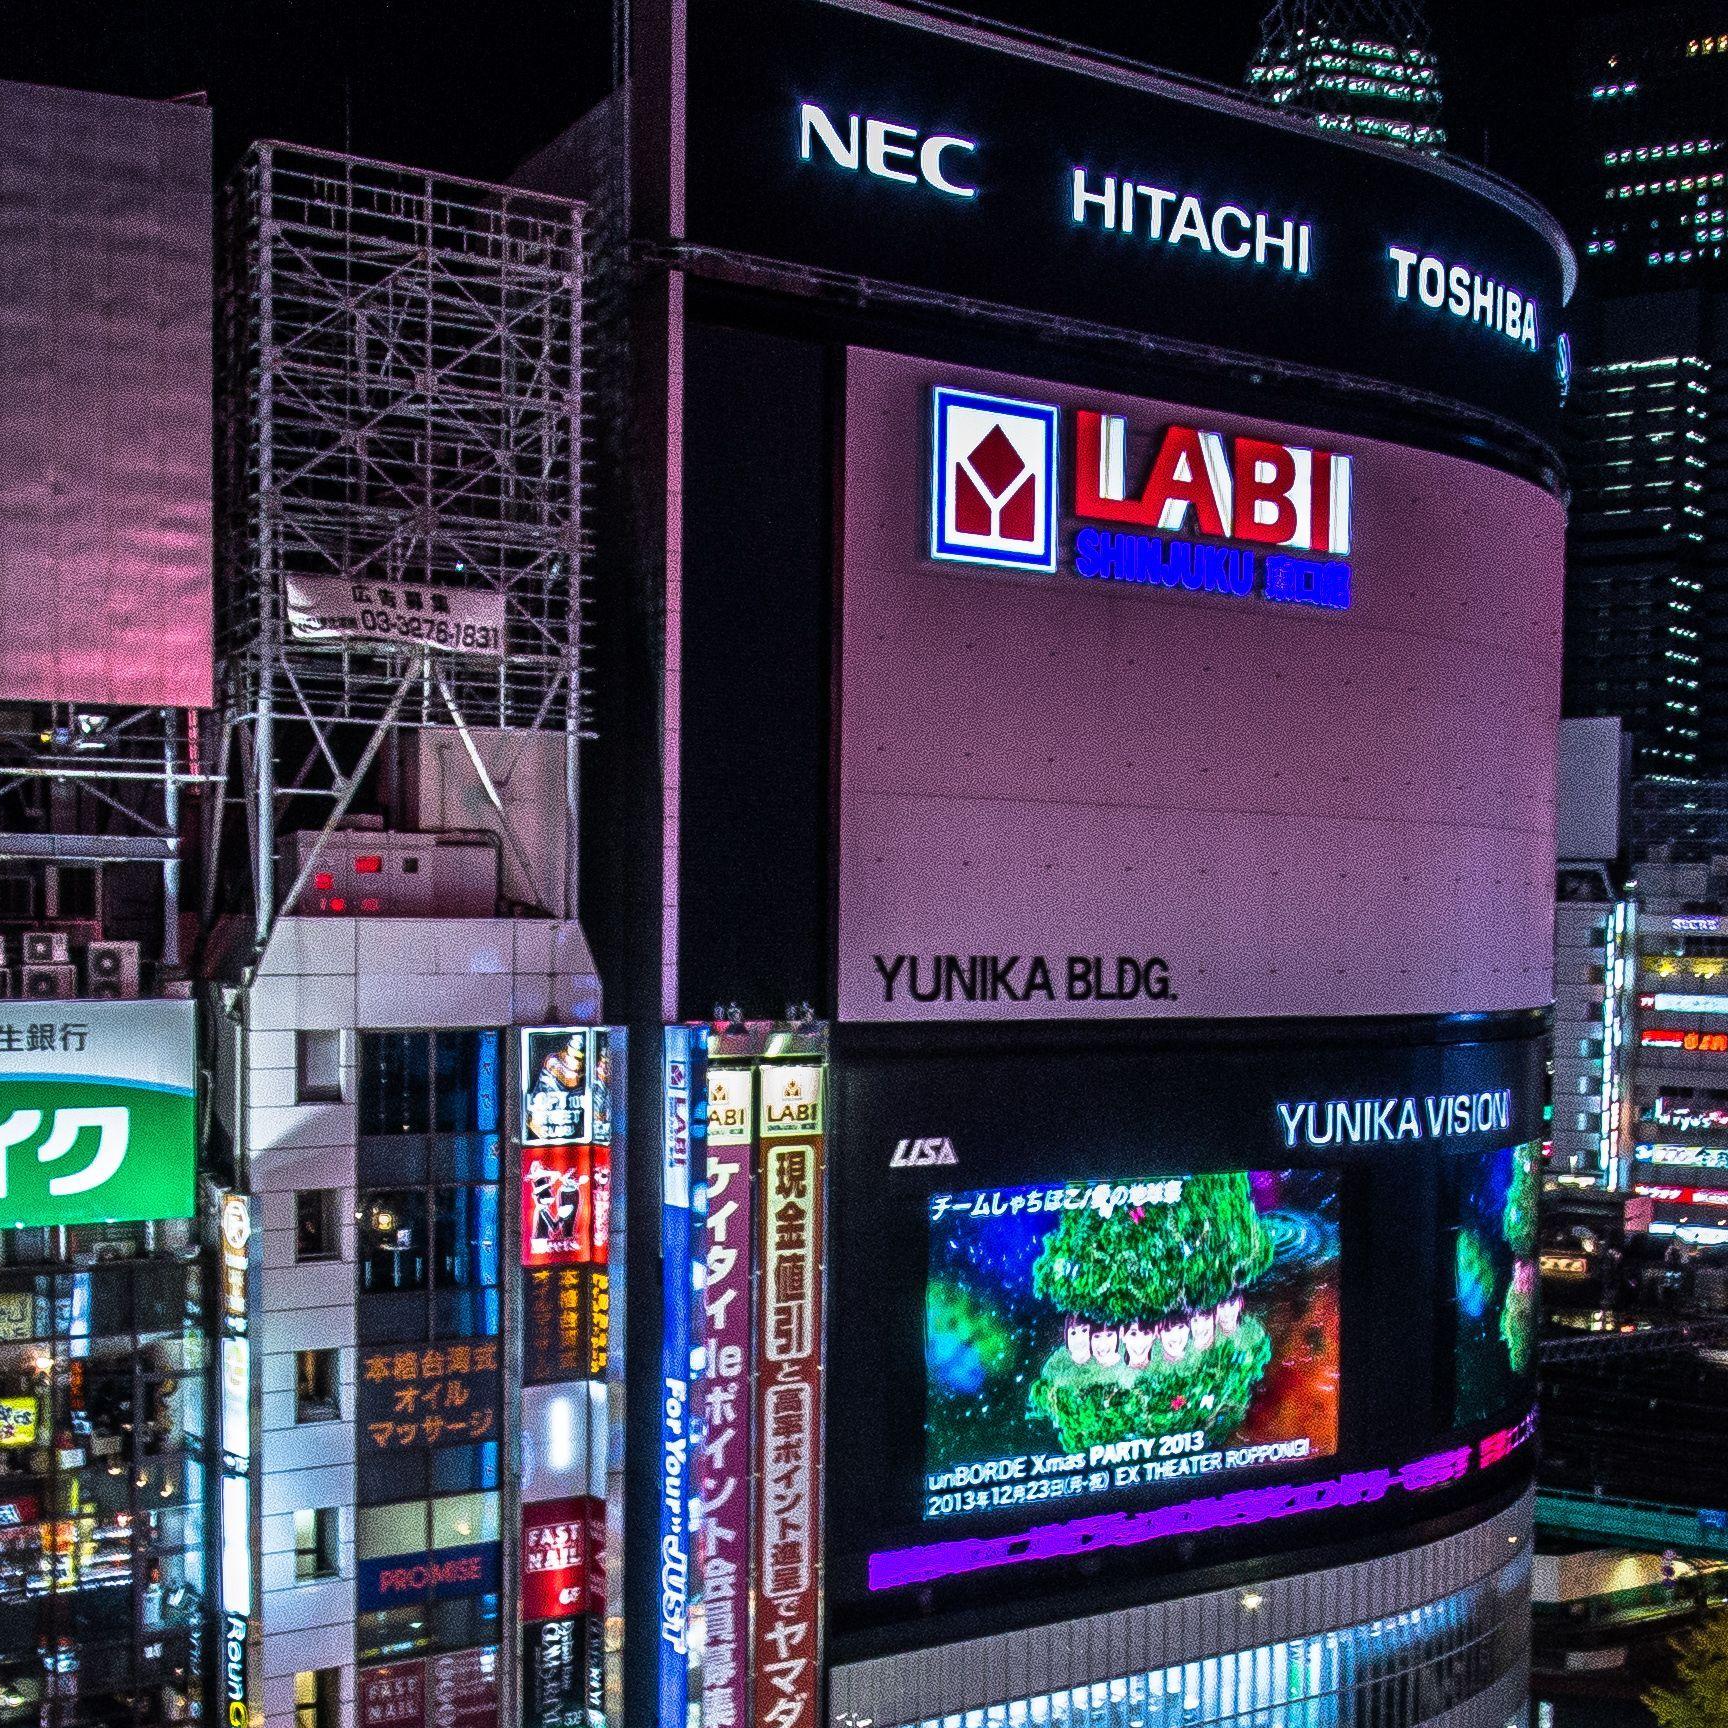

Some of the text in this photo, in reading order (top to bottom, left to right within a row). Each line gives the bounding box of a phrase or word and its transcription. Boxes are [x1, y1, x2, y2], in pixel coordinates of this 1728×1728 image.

[799, 102, 977, 197] NEC
[1073, 166, 1311, 273] HITACHI
[1389, 246, 1539, 349] TOSHIBA
[1076, 410, 1353, 556] LABI
[1074, 529, 1255, 596] SHINJUKU
[352, 586, 450, 613] 広告募集
[874, 955, 1178, 1002] YUNIKA BLDG.
[709, 1107, 746, 1126] ABI
[768, 1103, 818, 1124] LABI
[1280, 1088, 1510, 1146] YUNIKA VISION
[364, 1345, 497, 1383] 本格台湾式
[394, 1381, 470, 1413] オイル
[665, 1378, 686, 1434] For
[368, 1408, 493, 1448] マッサージ
[665, 1440, 686, 1513] Your
[928, 1431, 1204, 1490] unBORDE Xmas PARTY 2013
[1115, 1462, 1139, 1486] EX
[1145, 1451, 1222, 1482] THEATER
[527, 1523, 580, 1549] FAST
[379, 1557, 482, 1593] PROMISE
[526, 1549, 581, 1574] NAIL
[368, 1677, 417, 1699] FAST
[367, 1701, 418, 1724] NAIL
